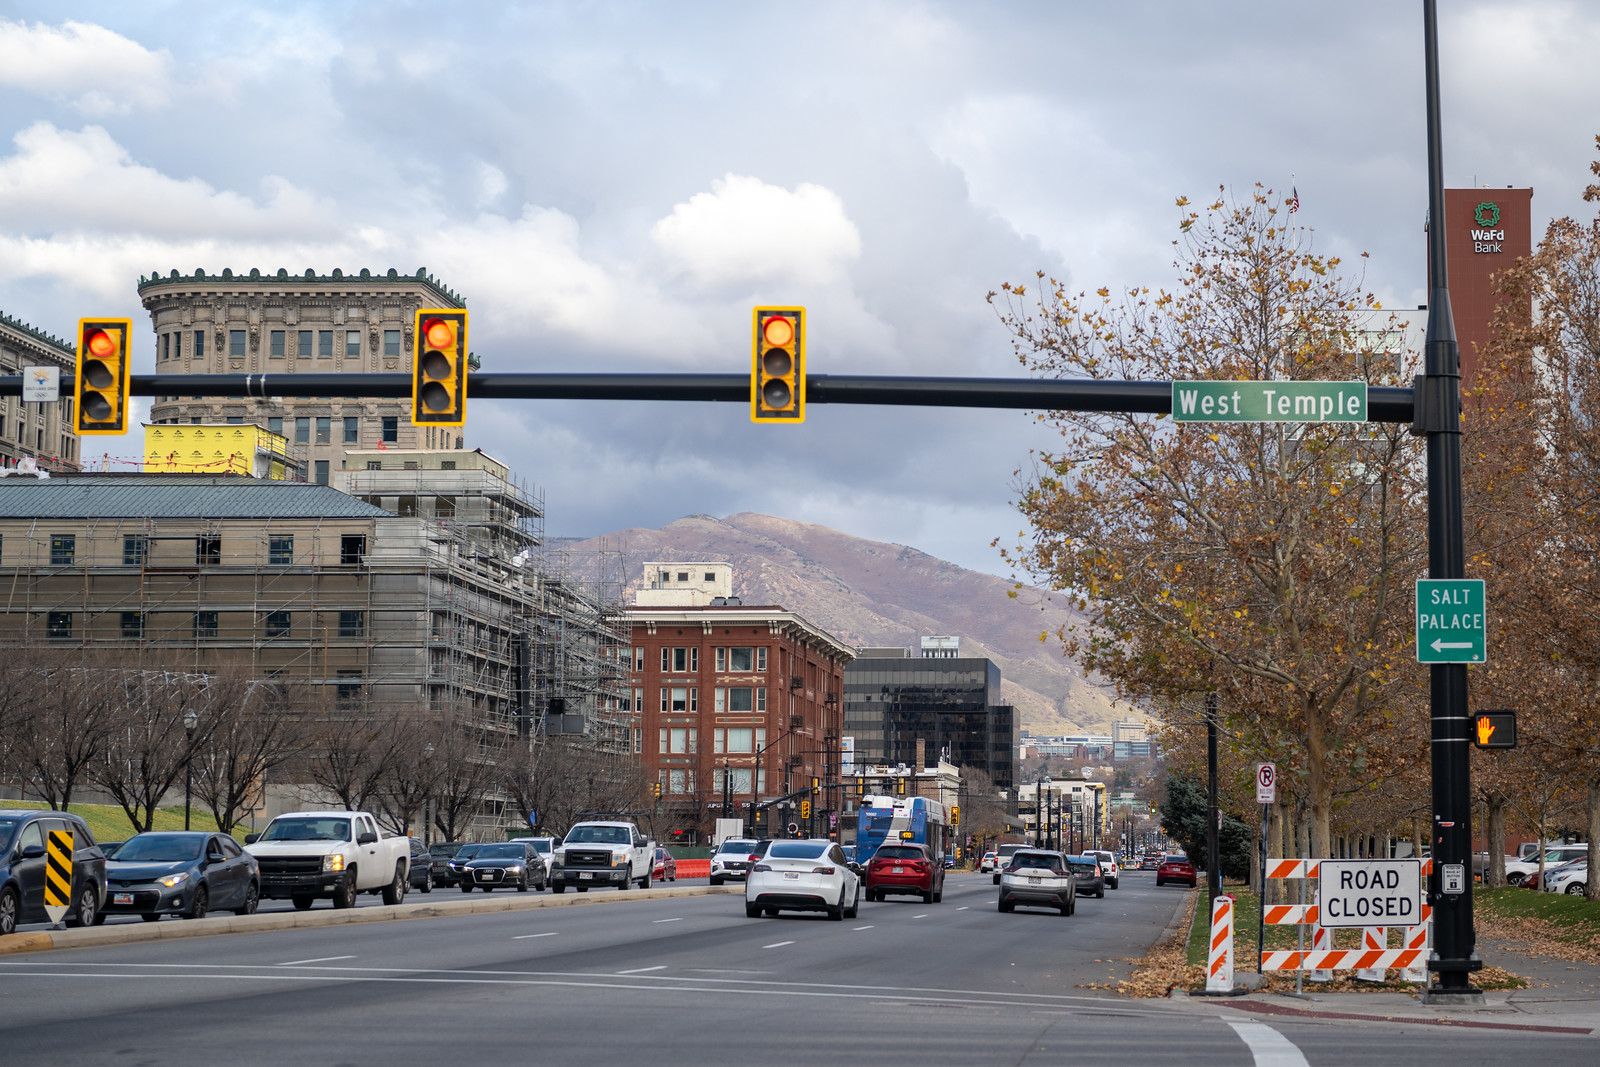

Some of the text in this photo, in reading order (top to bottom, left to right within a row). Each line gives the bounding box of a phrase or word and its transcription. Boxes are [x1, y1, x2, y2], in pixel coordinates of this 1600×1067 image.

[1471, 230, 1504, 240] WaFd
[1475, 242, 1502, 253] Bank
[1179, 390, 1361, 421] West Temple
[1431, 589, 1470, 605] SALT
[1420, 614, 1482, 629] PALACE
[902, 831, 912, 839] 170
[1341, 870, 1399, 889] ROAD
[1328, 897, 1412, 917] CLOSED
